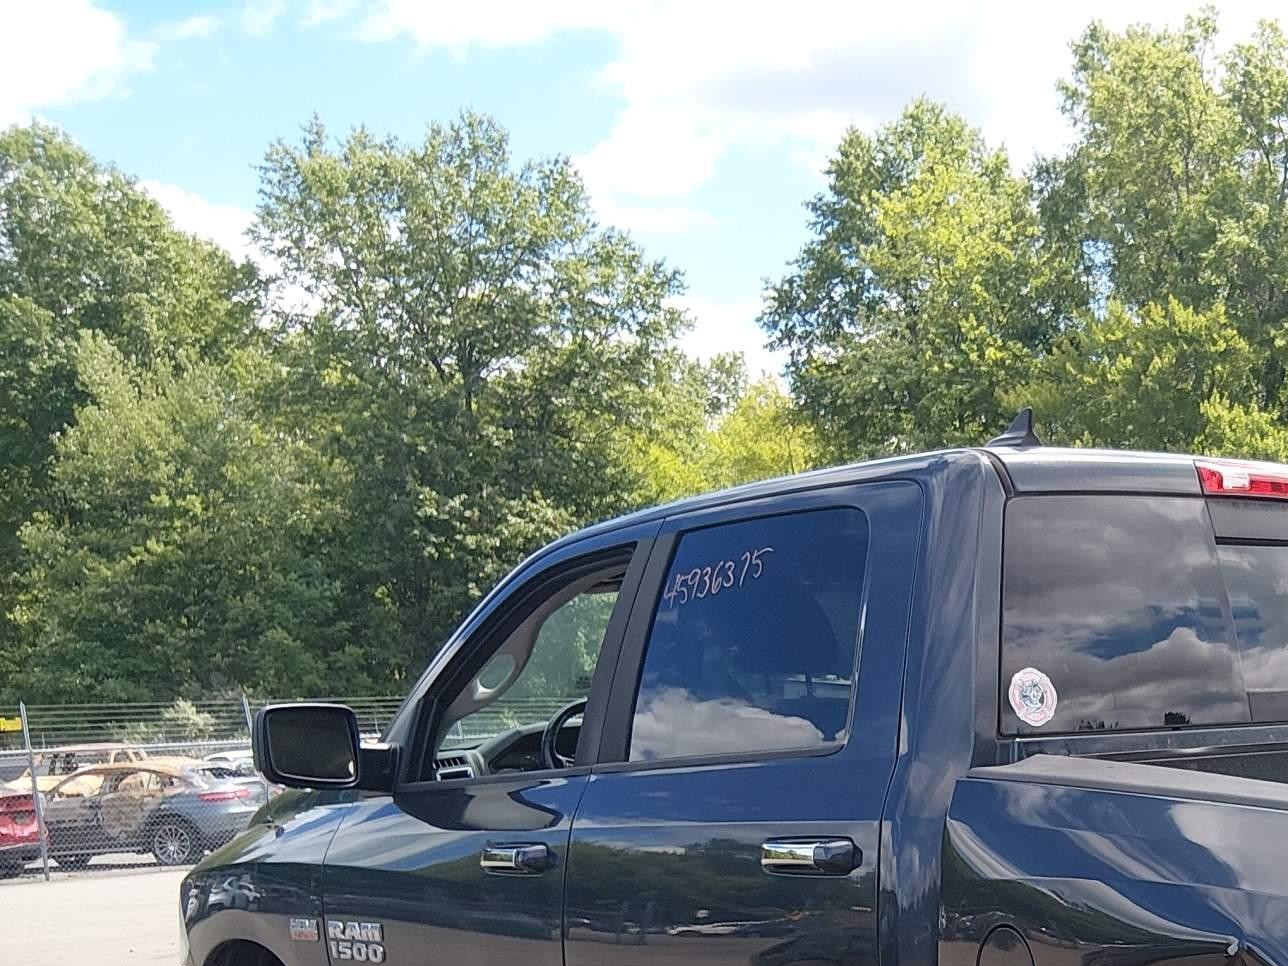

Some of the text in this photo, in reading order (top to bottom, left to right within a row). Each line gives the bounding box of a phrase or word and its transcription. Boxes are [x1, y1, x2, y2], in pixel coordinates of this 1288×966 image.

[663, 547, 774, 608] 45936375
[327, 920, 382, 942] RAM
[330, 941, 385, 964] 1500
